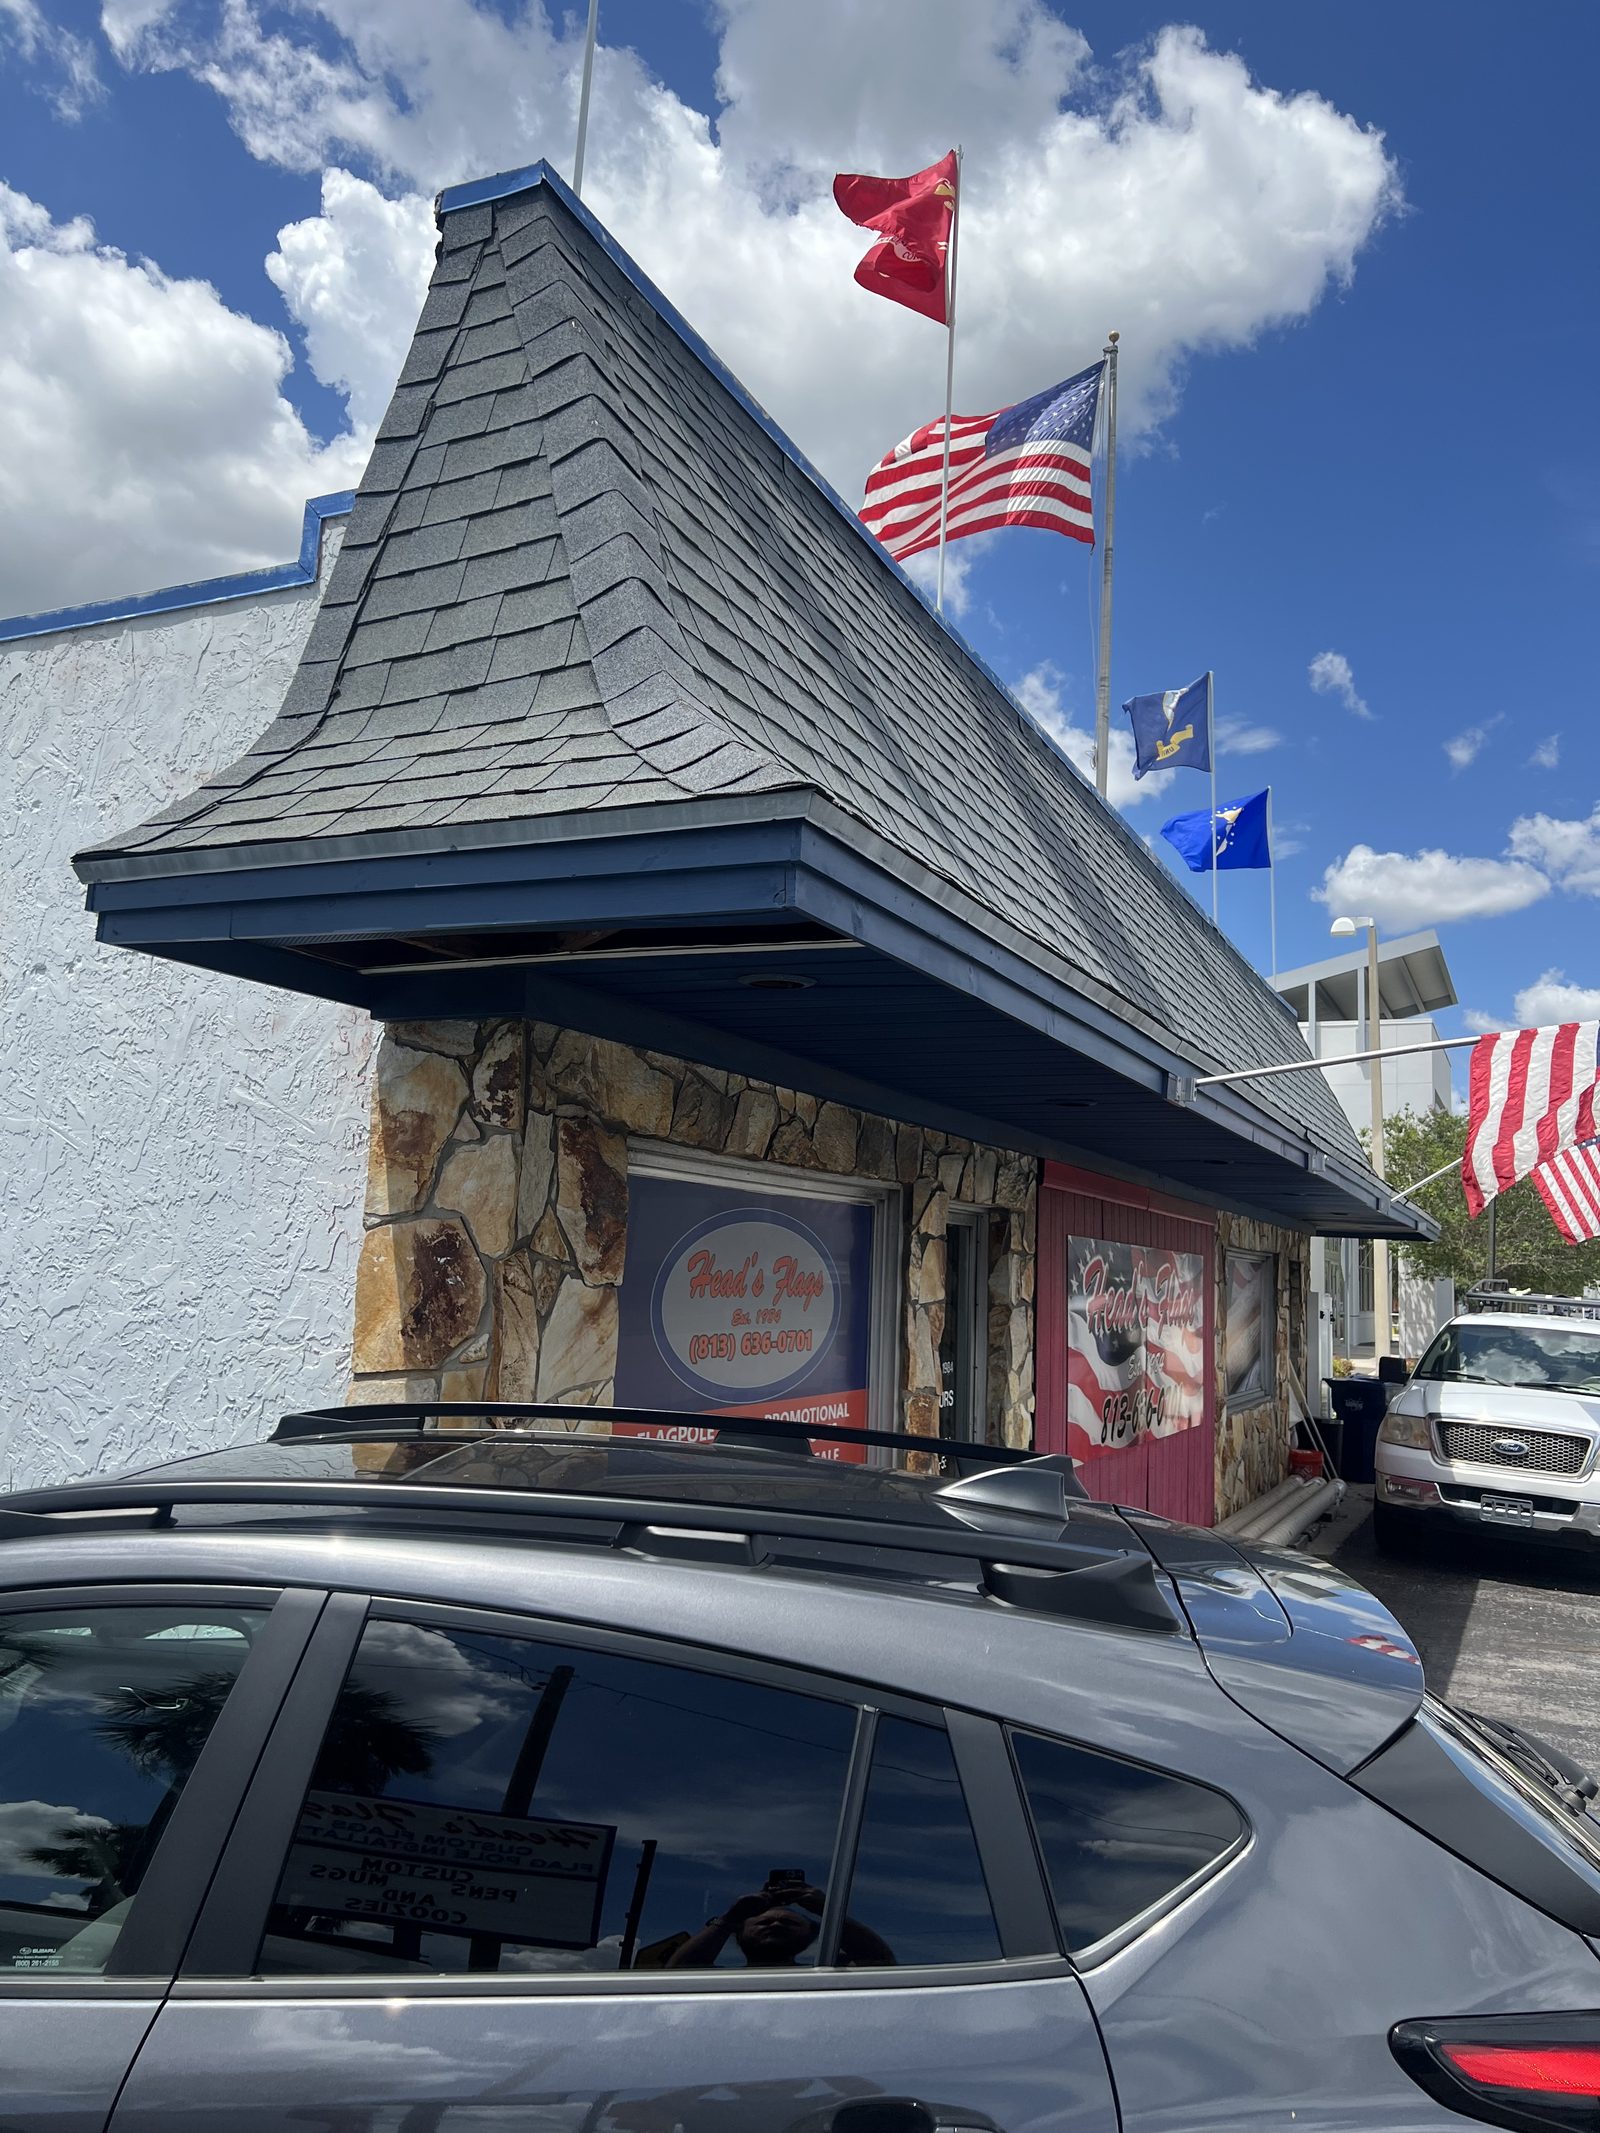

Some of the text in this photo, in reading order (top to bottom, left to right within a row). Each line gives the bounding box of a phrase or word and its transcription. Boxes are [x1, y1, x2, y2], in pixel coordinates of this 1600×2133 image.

[687, 1249, 824, 1311] Head's Flags
[689, 1329, 813, 1364] (813) 636-0701
